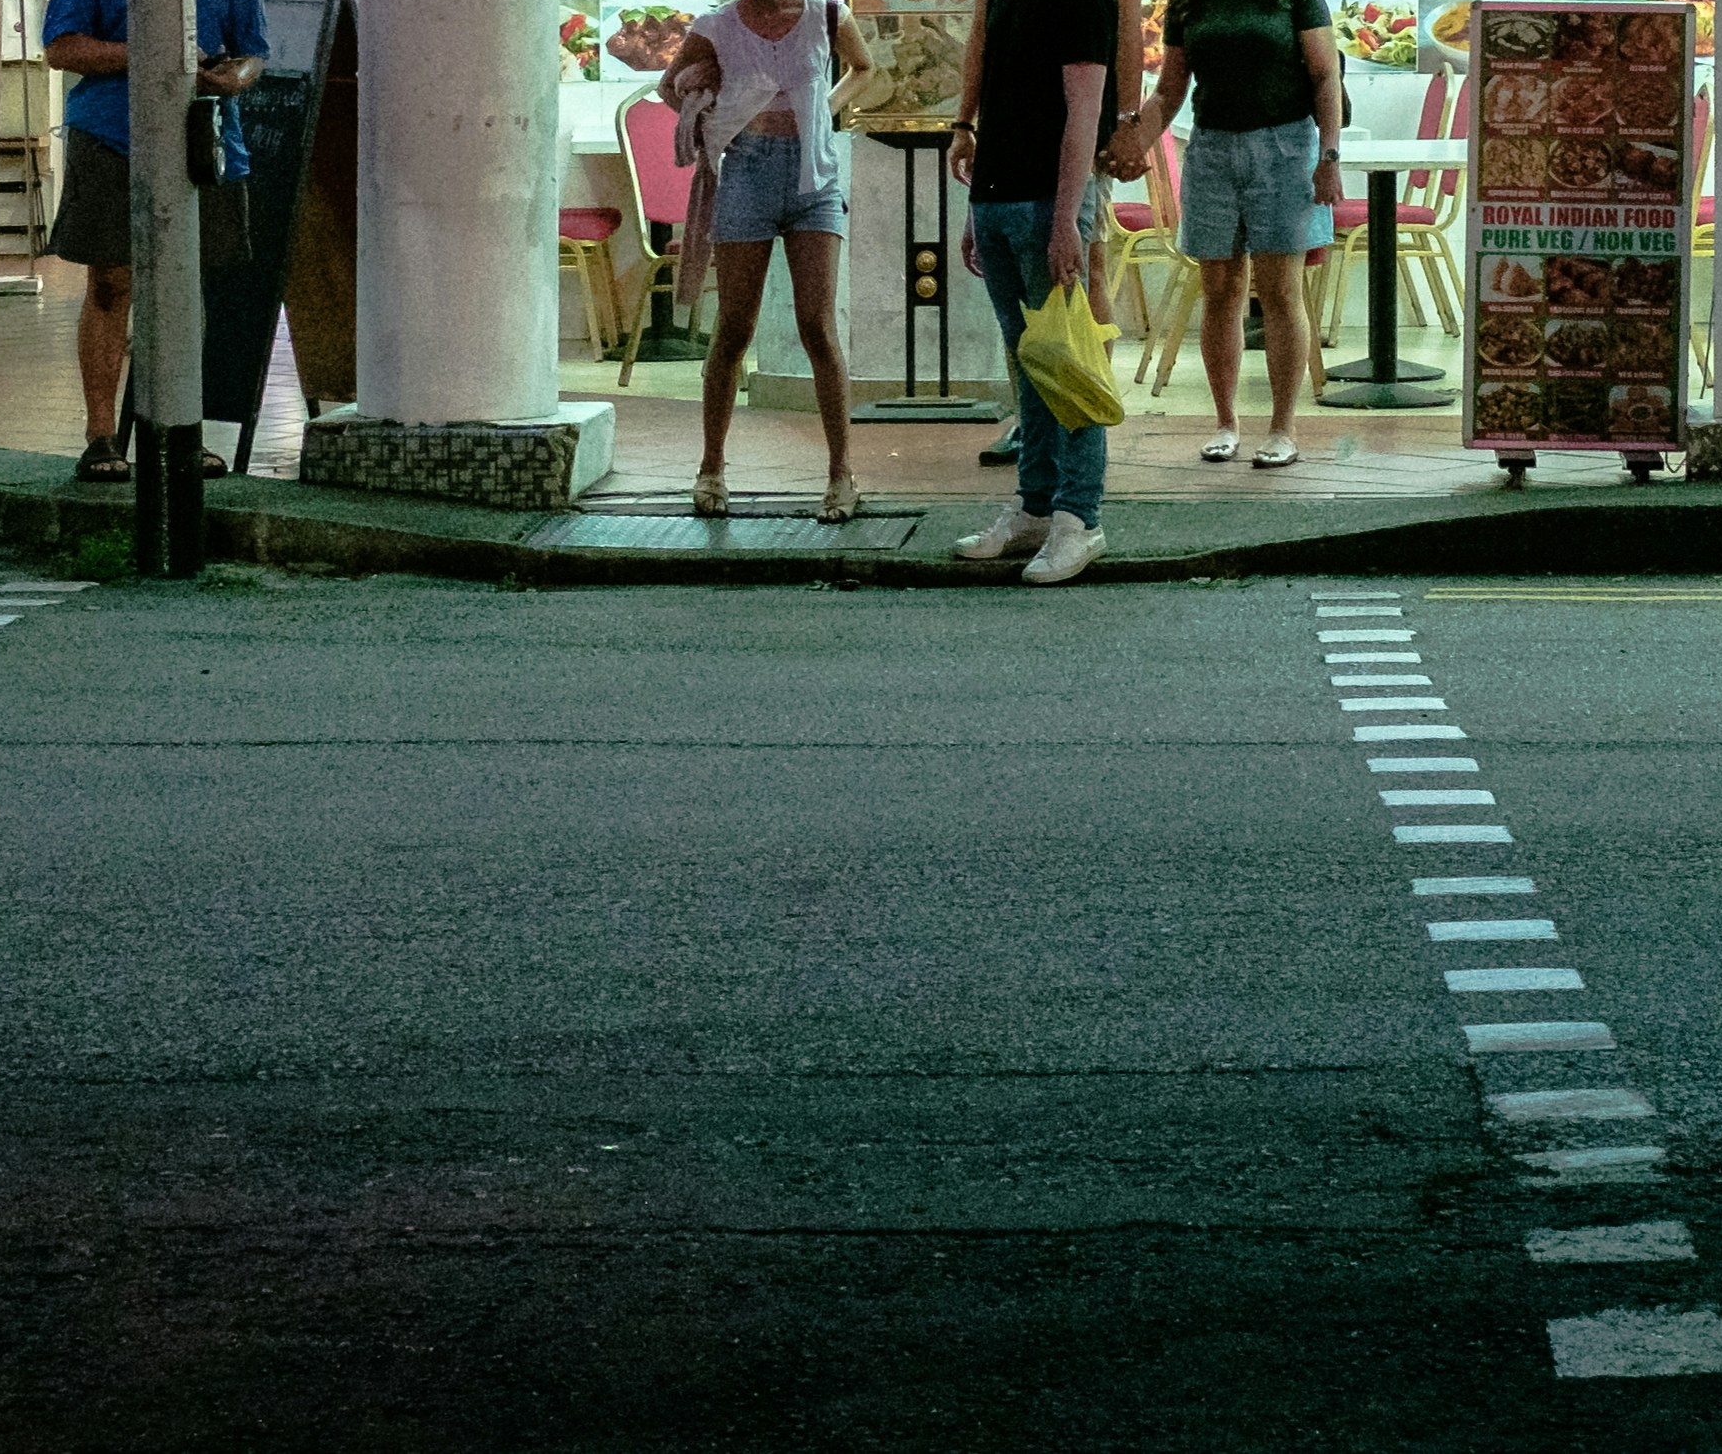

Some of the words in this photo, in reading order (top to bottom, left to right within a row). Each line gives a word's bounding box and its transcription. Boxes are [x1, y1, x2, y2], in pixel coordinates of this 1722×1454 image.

[1482, 205, 1543, 226] ROYAL
[1549, 207, 1619, 227] INDIAN
[1624, 208, 1676, 228] FOOD
[1482, 229, 1532, 248] PURE
[1536, 230, 1575, 249] VEG
[1592, 231, 1635, 251] NON
[1638, 231, 1676, 252] VEG
